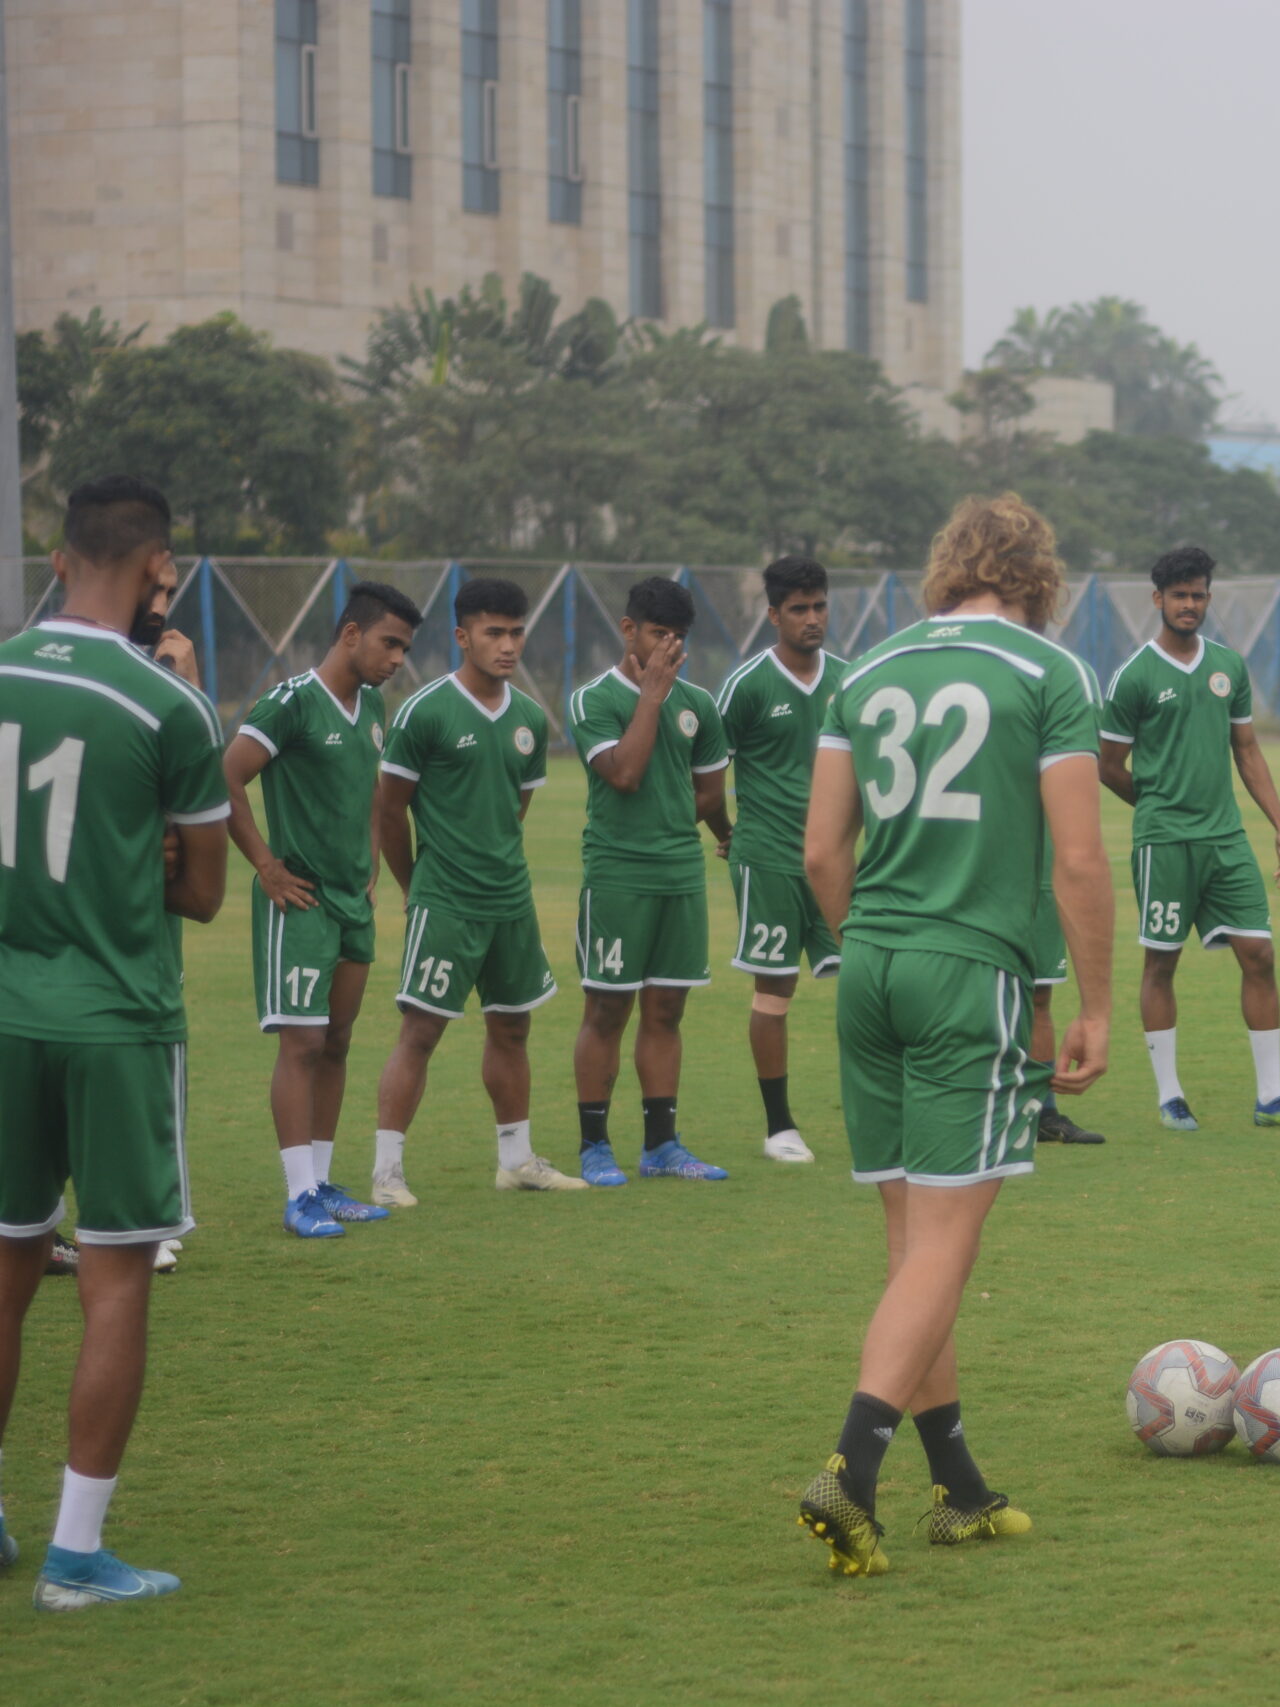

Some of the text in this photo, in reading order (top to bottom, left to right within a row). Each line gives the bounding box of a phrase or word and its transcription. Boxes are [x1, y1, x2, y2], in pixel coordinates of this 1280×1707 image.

[859, 682, 991, 821] 32
[1148, 900, 1181, 936] 35
[595, 937, 624, 976] 14
[750, 923, 787, 961] 22
[285, 966, 321, 1008] 17
[419, 955, 454, 999] 15
